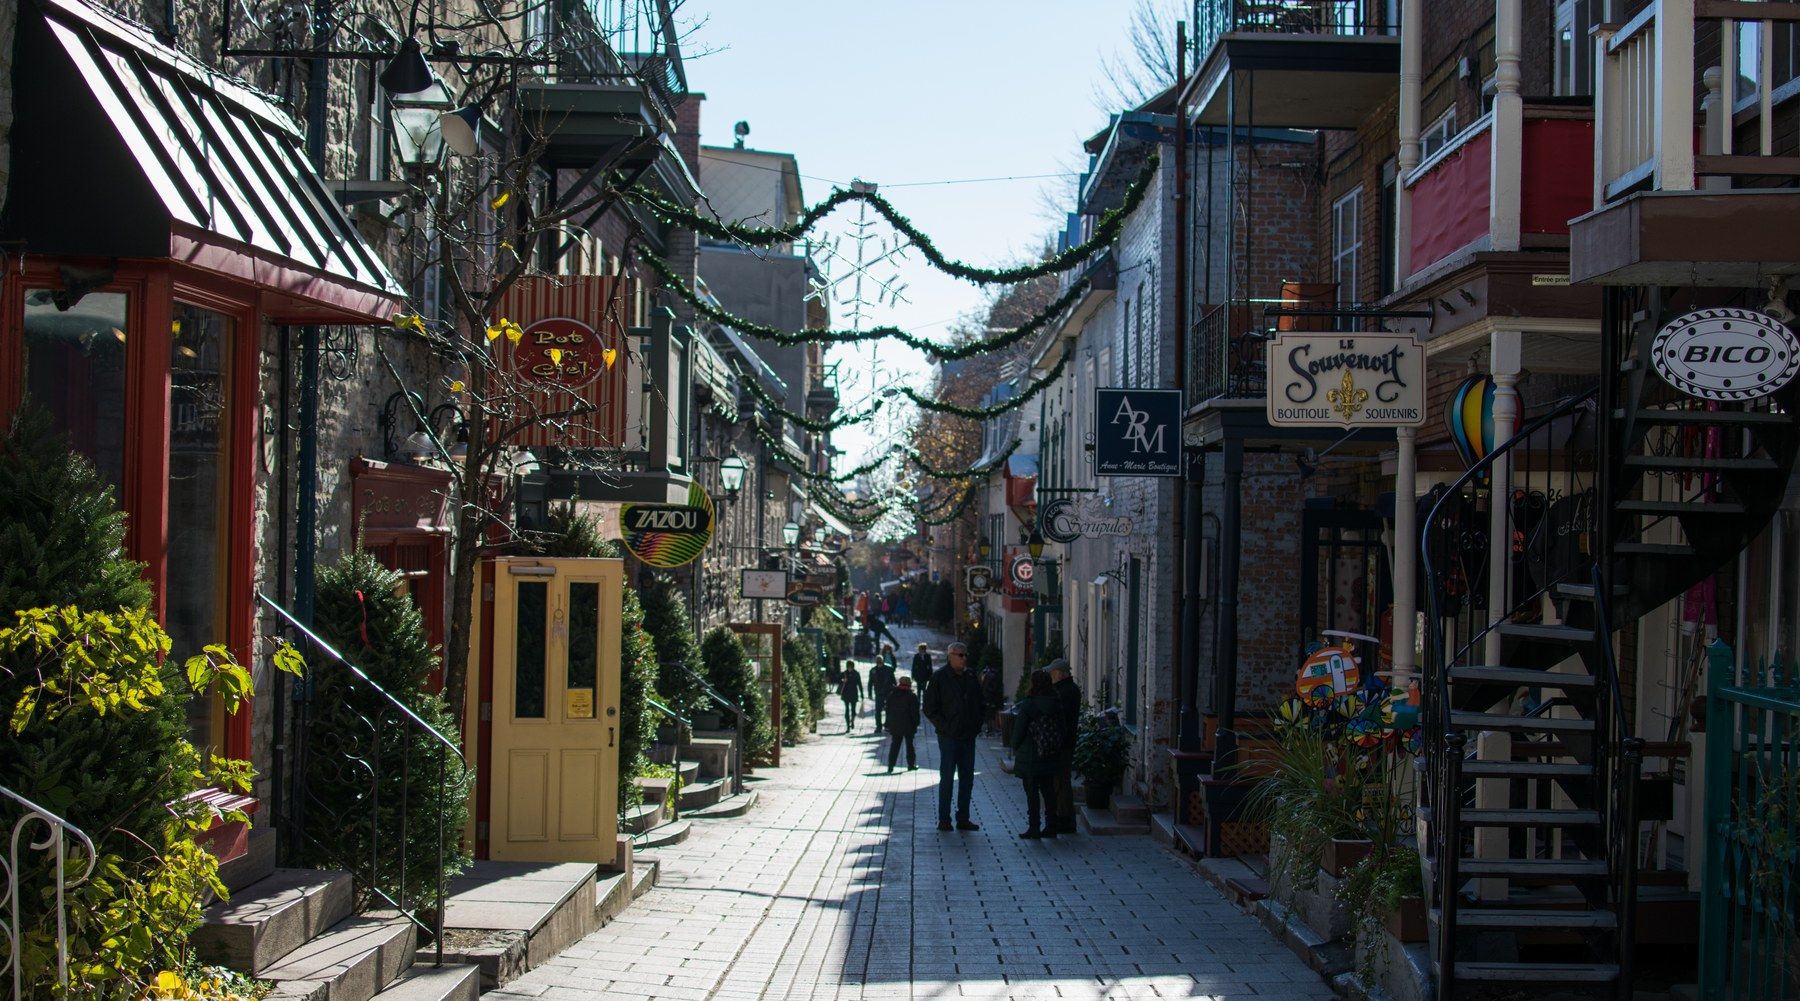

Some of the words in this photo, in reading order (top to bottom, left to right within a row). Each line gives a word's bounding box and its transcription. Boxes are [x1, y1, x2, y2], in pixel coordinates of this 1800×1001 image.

[1339, 339, 1354, 350] LE
[1683, 345, 1771, 364] BICO
[1277, 408, 1330, 420] BOUTIQUE
[1365, 408, 1418, 420] SOUVENIRS
[1148, 460, 1178, 473] Boutique
[635, 510, 697, 529] ZAZOU
